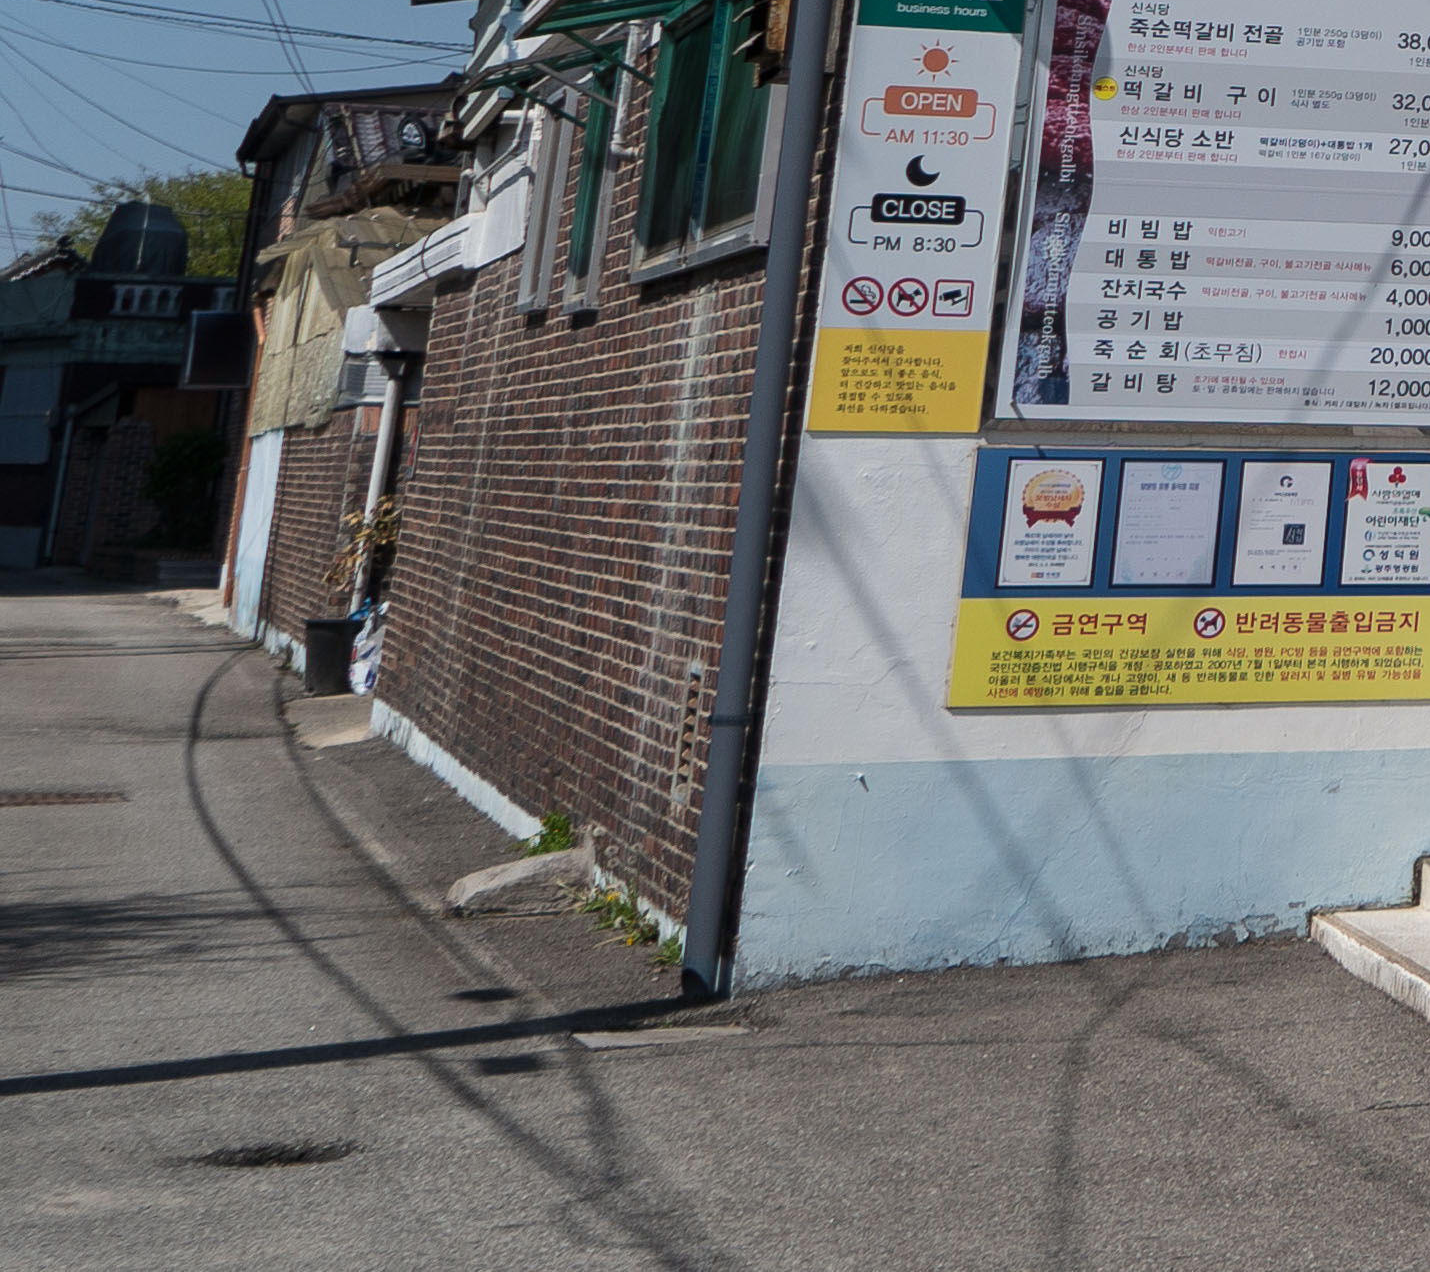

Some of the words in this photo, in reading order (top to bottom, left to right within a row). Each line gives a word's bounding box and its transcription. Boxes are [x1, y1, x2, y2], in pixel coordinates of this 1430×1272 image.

[896, 2, 950, 16] business
[954, 6, 988, 18] hours
[1131, 2, 1170, 16] 신식당
[1129, 17, 1235, 42] 죽순떡갈비
[1243, 24, 1285, 44] 전골
[1298, 27, 1323, 37] 1인분
[1324, 28, 1348, 40] 250g
[1296, 37, 1325, 48] 공기밥
[1327, 38, 1346, 48] 포함
[1124, 65, 1164, 78] 신식당
[901, 91, 963, 112] OPEN
[884, 129, 915, 144] AM
[922, 130, 969, 146] 11:30
[1119, 126, 1185, 148] 신식당
[1191, 130, 1235, 150] 소반
[882, 200, 956, 219] CLOSE
[873, 236, 901, 251] PM
[913, 237, 956, 252] 8:30
[1101, 279, 1187, 301] 잔치국수
[1366, 515, 1420, 528] 어린이재단
[1052, 612, 1147, 636] 금연구역
[1236, 610, 1420, 634] 반려동물출입금지
